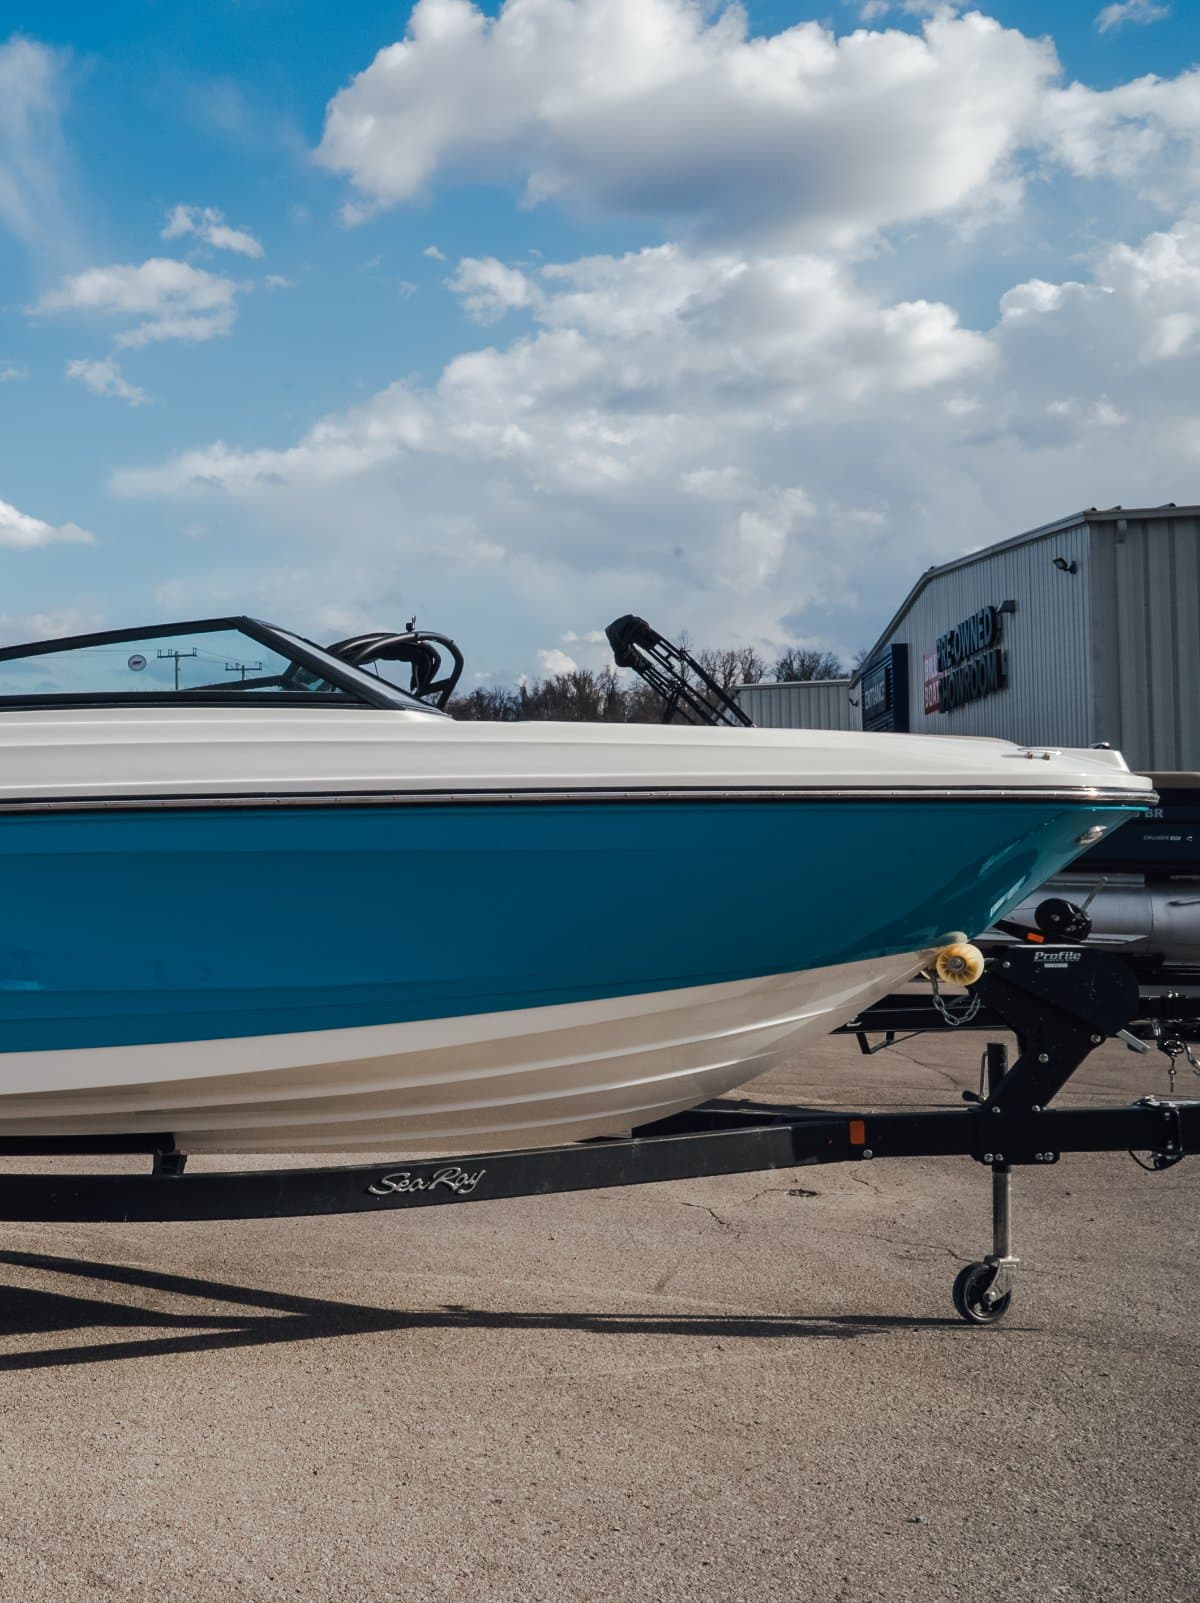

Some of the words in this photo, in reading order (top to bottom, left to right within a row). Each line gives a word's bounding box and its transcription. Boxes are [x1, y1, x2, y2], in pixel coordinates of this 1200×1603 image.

[939, 650, 998, 713] HOWROOM
[1034, 951, 1081, 960] Profile
[368, 1172, 430, 1195] Sea
[428, 1167, 487, 1194] Ray
